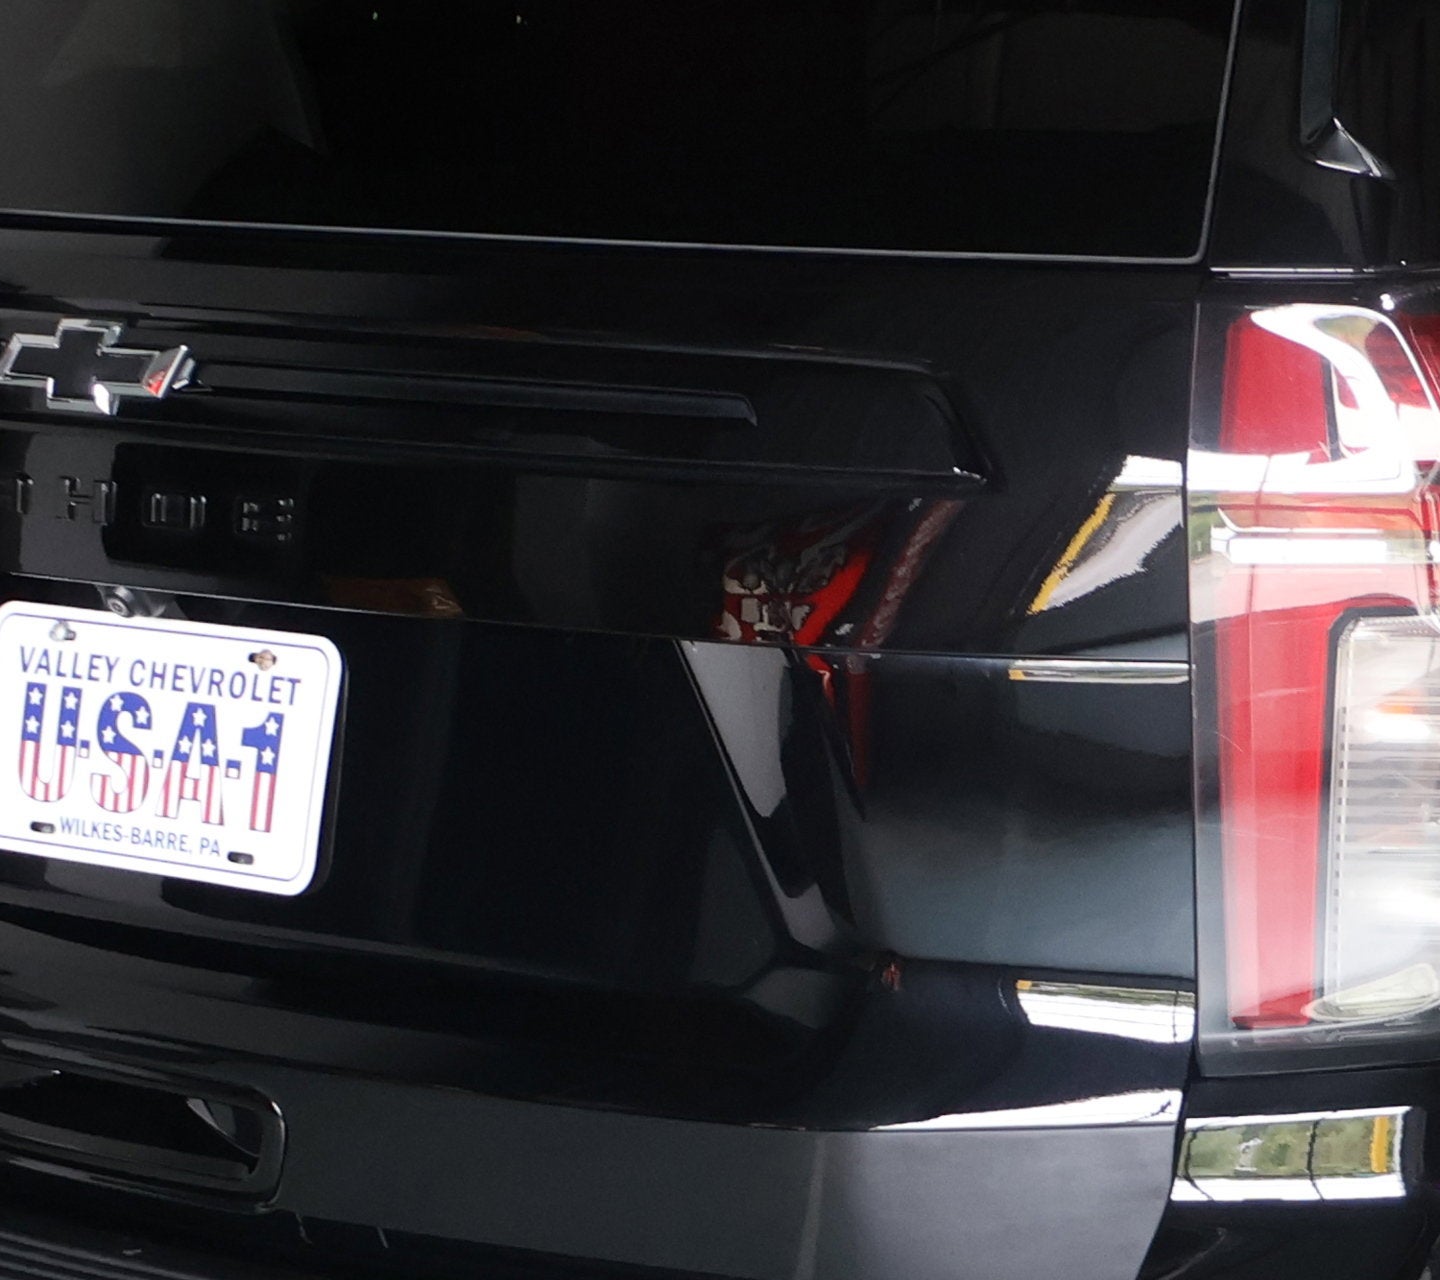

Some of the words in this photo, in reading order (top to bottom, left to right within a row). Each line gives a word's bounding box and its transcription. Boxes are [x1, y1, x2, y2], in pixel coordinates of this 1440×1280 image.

[19, 645, 121, 685] VALLEY
[129, 659, 303, 706] CHEVROLET
[59, 815, 193, 855] WILKES-BARRE,
[199, 837, 222, 858] PA
